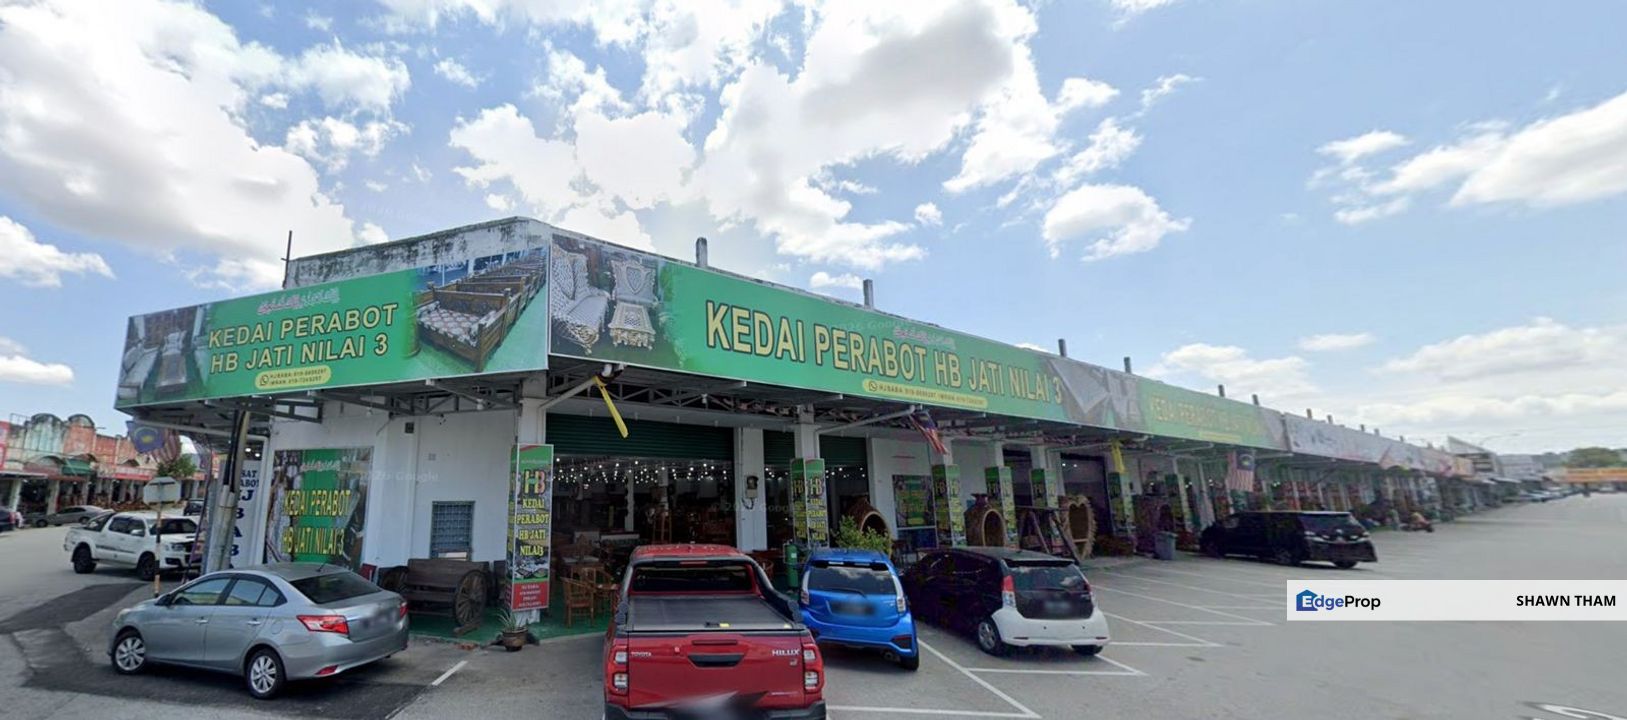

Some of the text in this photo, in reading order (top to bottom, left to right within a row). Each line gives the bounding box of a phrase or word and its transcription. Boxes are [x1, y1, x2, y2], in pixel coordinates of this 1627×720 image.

[208, 303, 398, 349] KEDAI PERABOT
[210, 333, 389, 374] HB JATI NILAI 3
[706, 300, 806, 363] KEDAI
[814, 323, 927, 382] PERABOT
[933, 349, 961, 388] HB
[969, 358, 1004, 395] JATI
[1008, 365, 1049, 402] NILAI
[1052, 376, 1063, 404] 3
[524, 469, 546, 495] HB
[283, 489, 351, 516] KEDAI PERABOT
[522, 499, 545, 509] KEDAI
[516, 513, 549, 524] PERABOT
